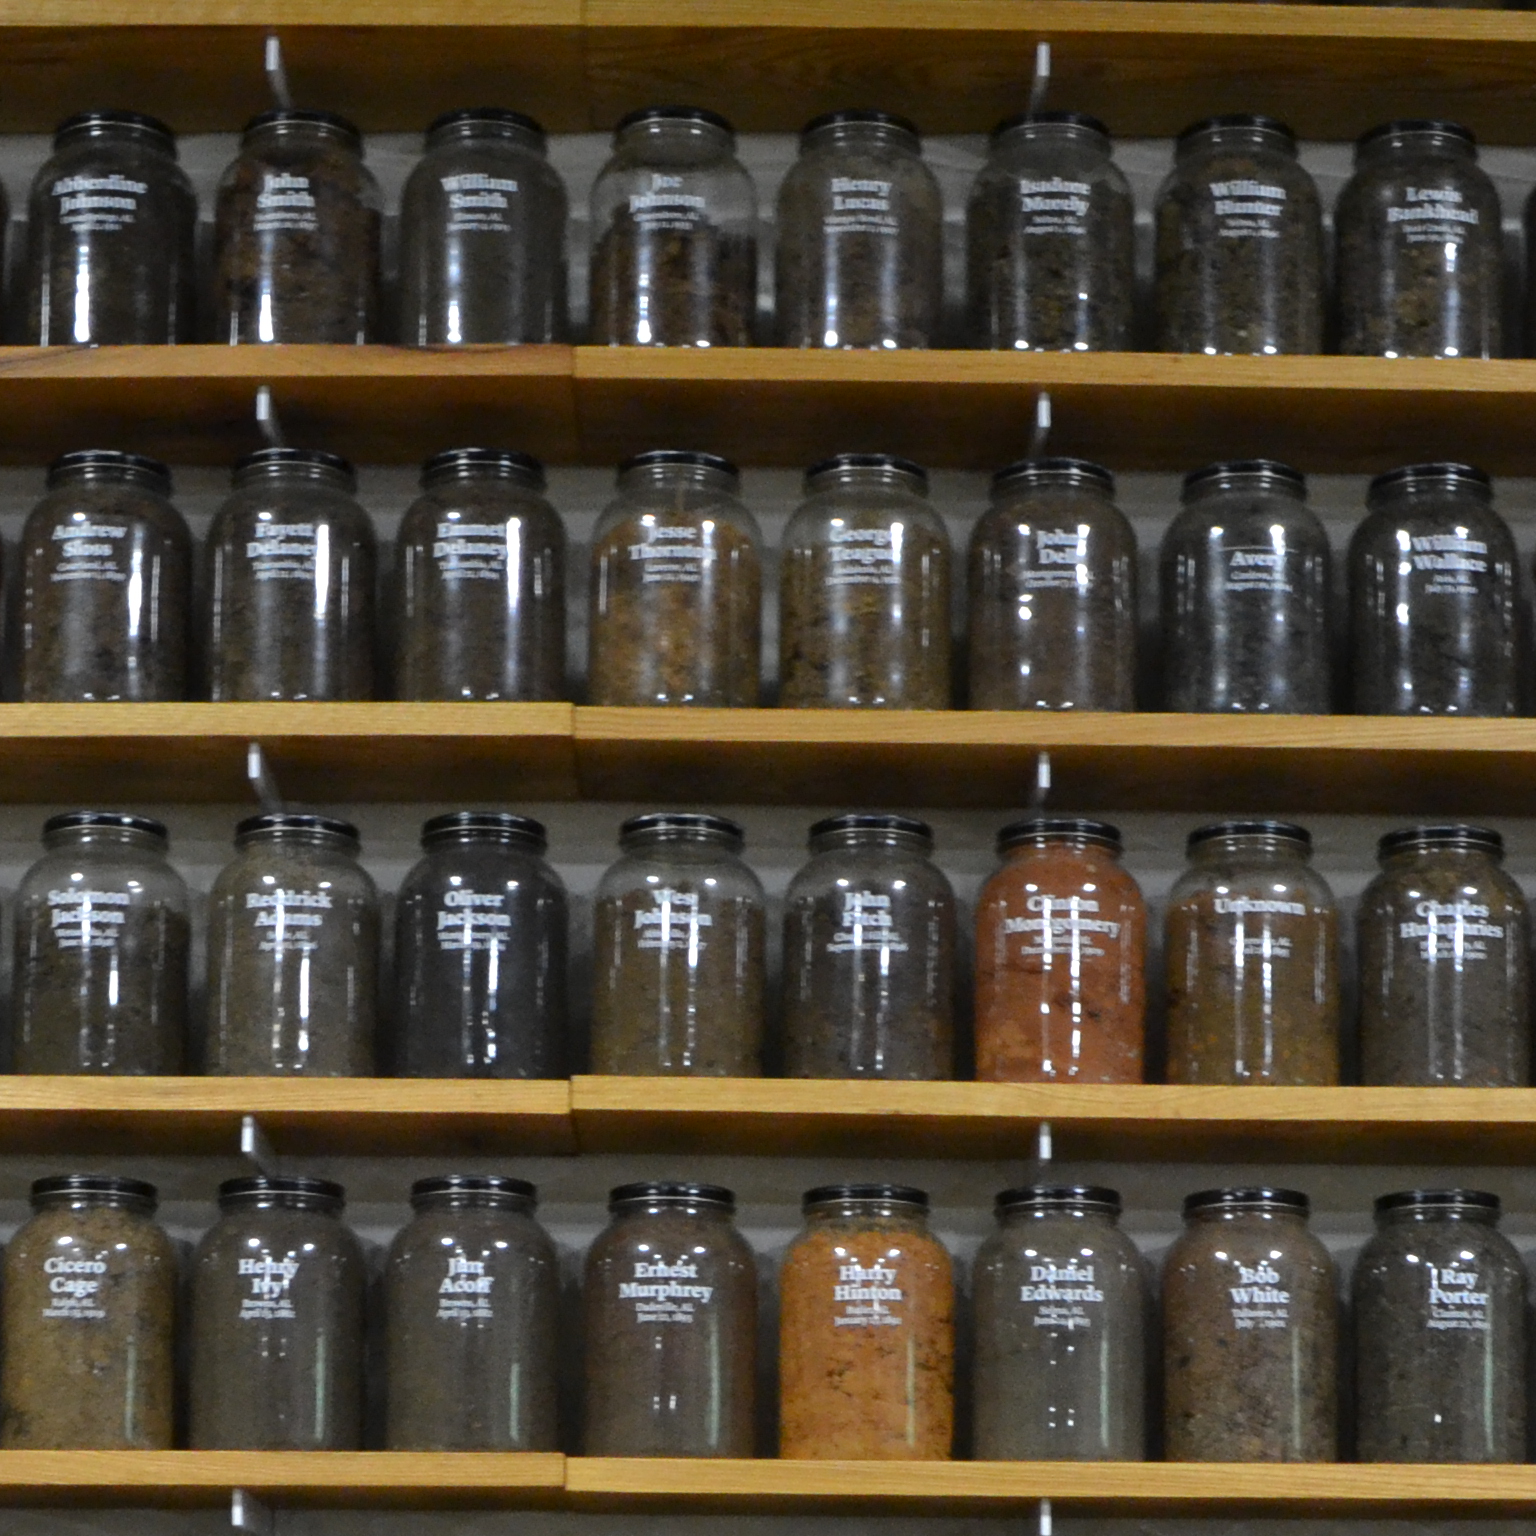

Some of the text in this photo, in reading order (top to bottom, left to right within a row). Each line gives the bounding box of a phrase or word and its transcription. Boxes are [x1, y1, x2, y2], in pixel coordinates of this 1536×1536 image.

[443, 891, 505, 908] Oliver
[1238, 1268, 1281, 1285] Bob
[1229, 1285, 1290, 1304] White
